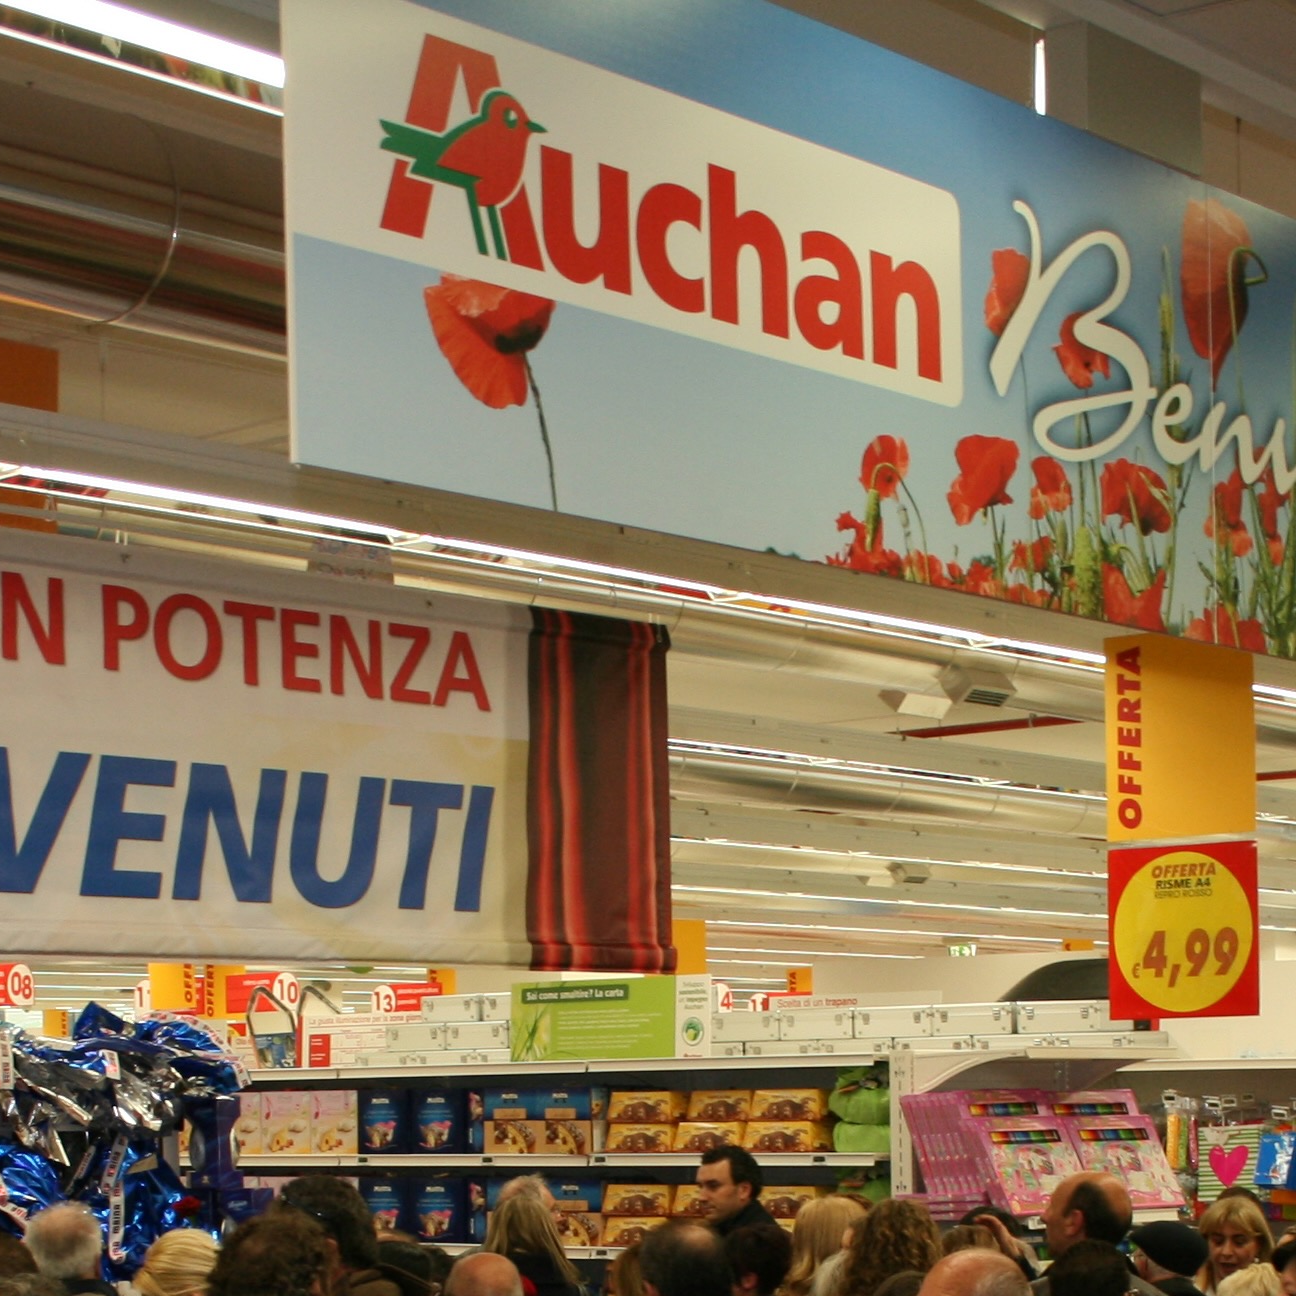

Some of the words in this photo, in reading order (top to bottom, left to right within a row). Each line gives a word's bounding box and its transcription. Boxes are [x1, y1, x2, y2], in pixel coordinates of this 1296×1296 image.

[378, 32, 944, 384] Auchan
[102, 583, 493, 713] POTENZA
[1117, 646, 1142, 830] OFFERTA
[1152, 862, 1216, 879] OFFERTA
[1183, 888, 1213, 898] ROSSO
[11, 971, 32, 999] 08
[278, 979, 299, 1004] 10
[526, 990, 537, 1000] Sai
[539, 991, 557, 1000] come
[373, 991, 394, 1012] 13
[777, 999, 802, 1009] Scelta
[825, 998, 858, 1009] trapano
